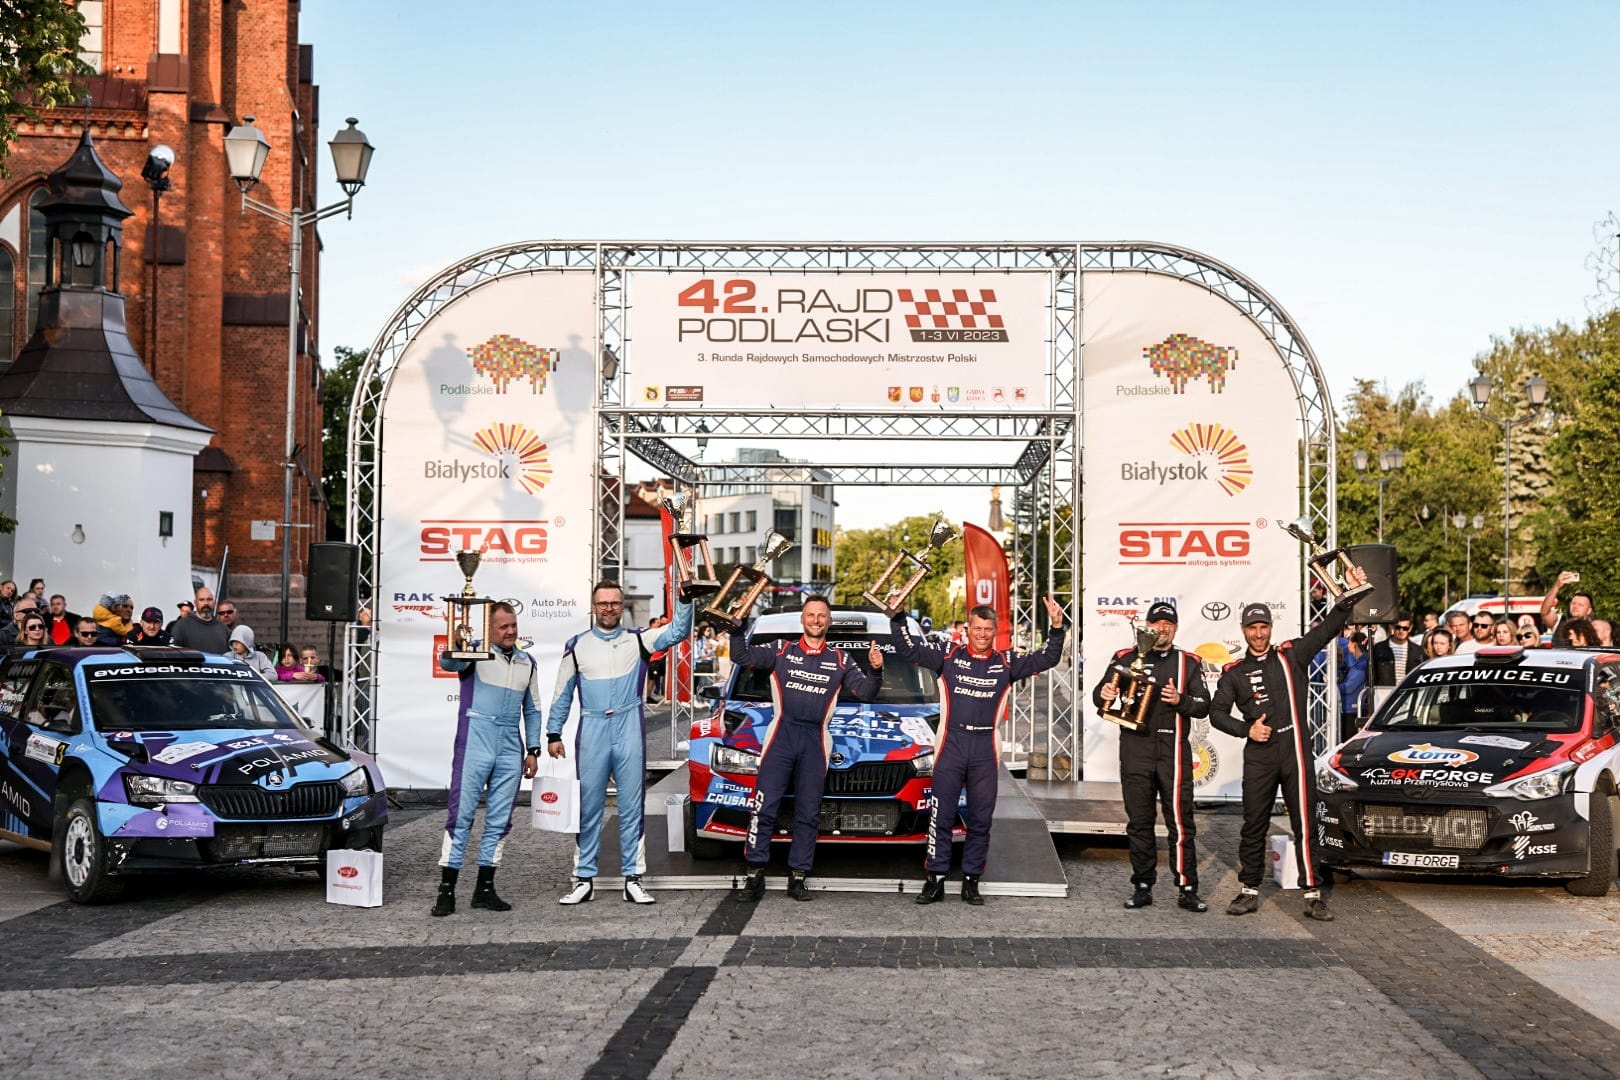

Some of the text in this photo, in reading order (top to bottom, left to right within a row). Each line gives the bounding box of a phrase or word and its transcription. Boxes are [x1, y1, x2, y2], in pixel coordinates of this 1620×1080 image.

[678, 279, 893, 313] 42. RAJD
[678, 318, 890, 343] PODLASKI
[920, 332, 1000, 341] 1-3 VI 2023
[697, 353, 977, 364] 3. Runda Rajdowych Samochodowych Mistrzostw Polski
[440, 384, 494, 395] Podlaskie
[1116, 385, 1171, 396] Podlaskie
[424, 459, 510, 484] Białystok
[1121, 461, 1208, 485] Białystok
[420, 527, 548, 555] STAG
[1119, 530, 1250, 557] STAG
[1187, 559, 1251, 567] autogas systems
[393, 593, 434, 602] RAK
[531, 599, 577, 607] Auto Park
[1097, 597, 1139, 606] RAK
[531, 609, 573, 619] Białystok
[94, 665, 253, 678] evotech.com.pl
[1416, 669, 1571, 685] KATOWICE.EU
[785, 681, 828, 695] CRUSAR
[953, 686, 996, 698] CRUSAR
[1404, 778, 1469, 788] Przemysłowa
[1528, 845, 1557, 855] KSSE
[1415, 855, 1457, 867] FORGE
